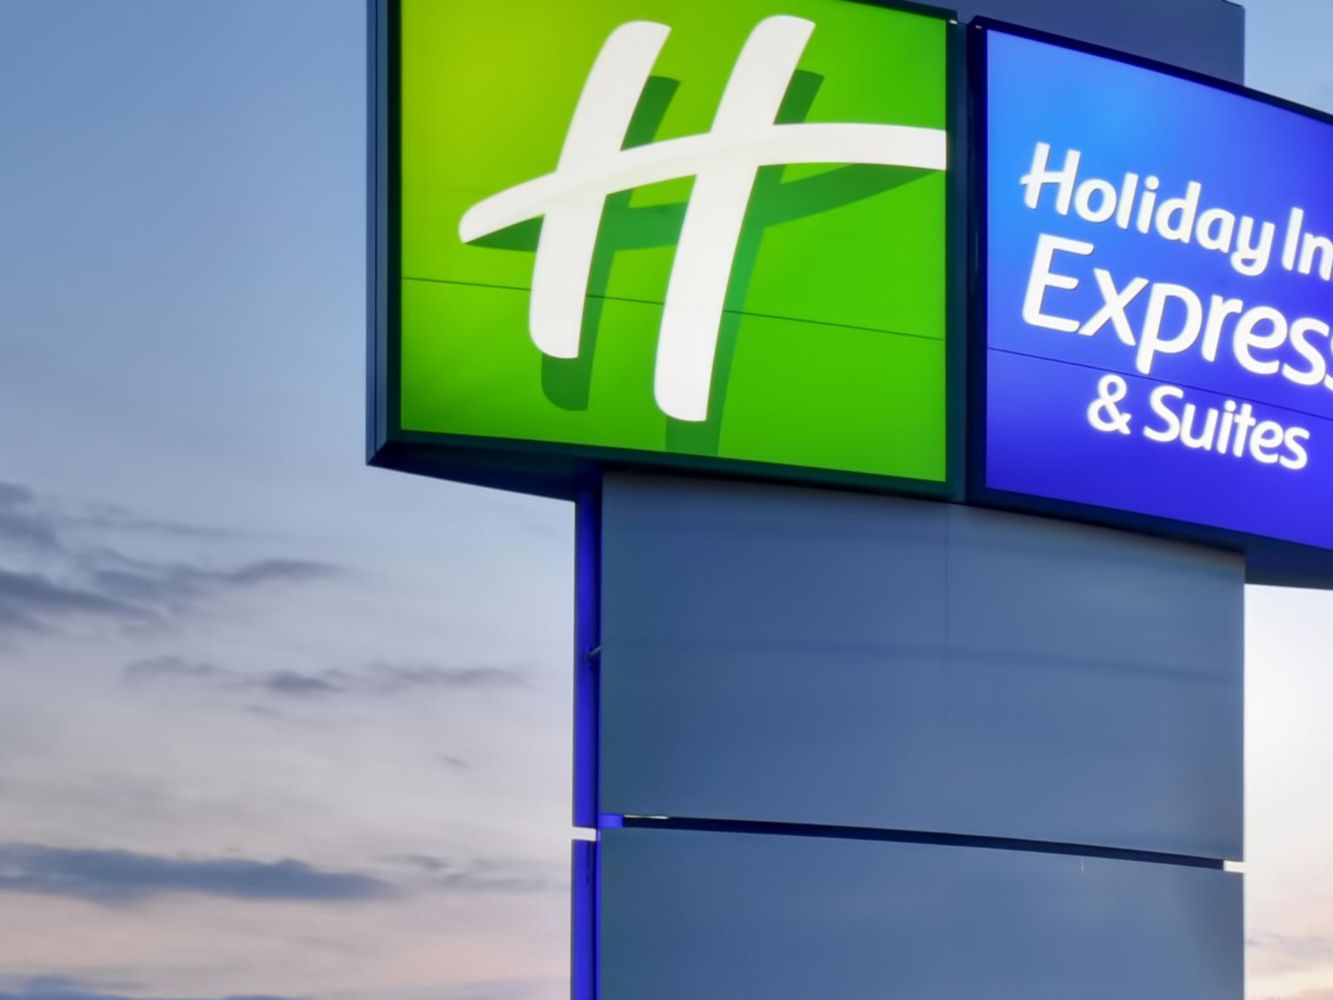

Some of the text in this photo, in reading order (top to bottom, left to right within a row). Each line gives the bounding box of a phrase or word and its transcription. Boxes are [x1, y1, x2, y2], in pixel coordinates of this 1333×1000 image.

[458, 14, 947, 423] H
[1019, 141, 1276, 277] Holiday
[1086, 373, 1311, 471] & Suites
